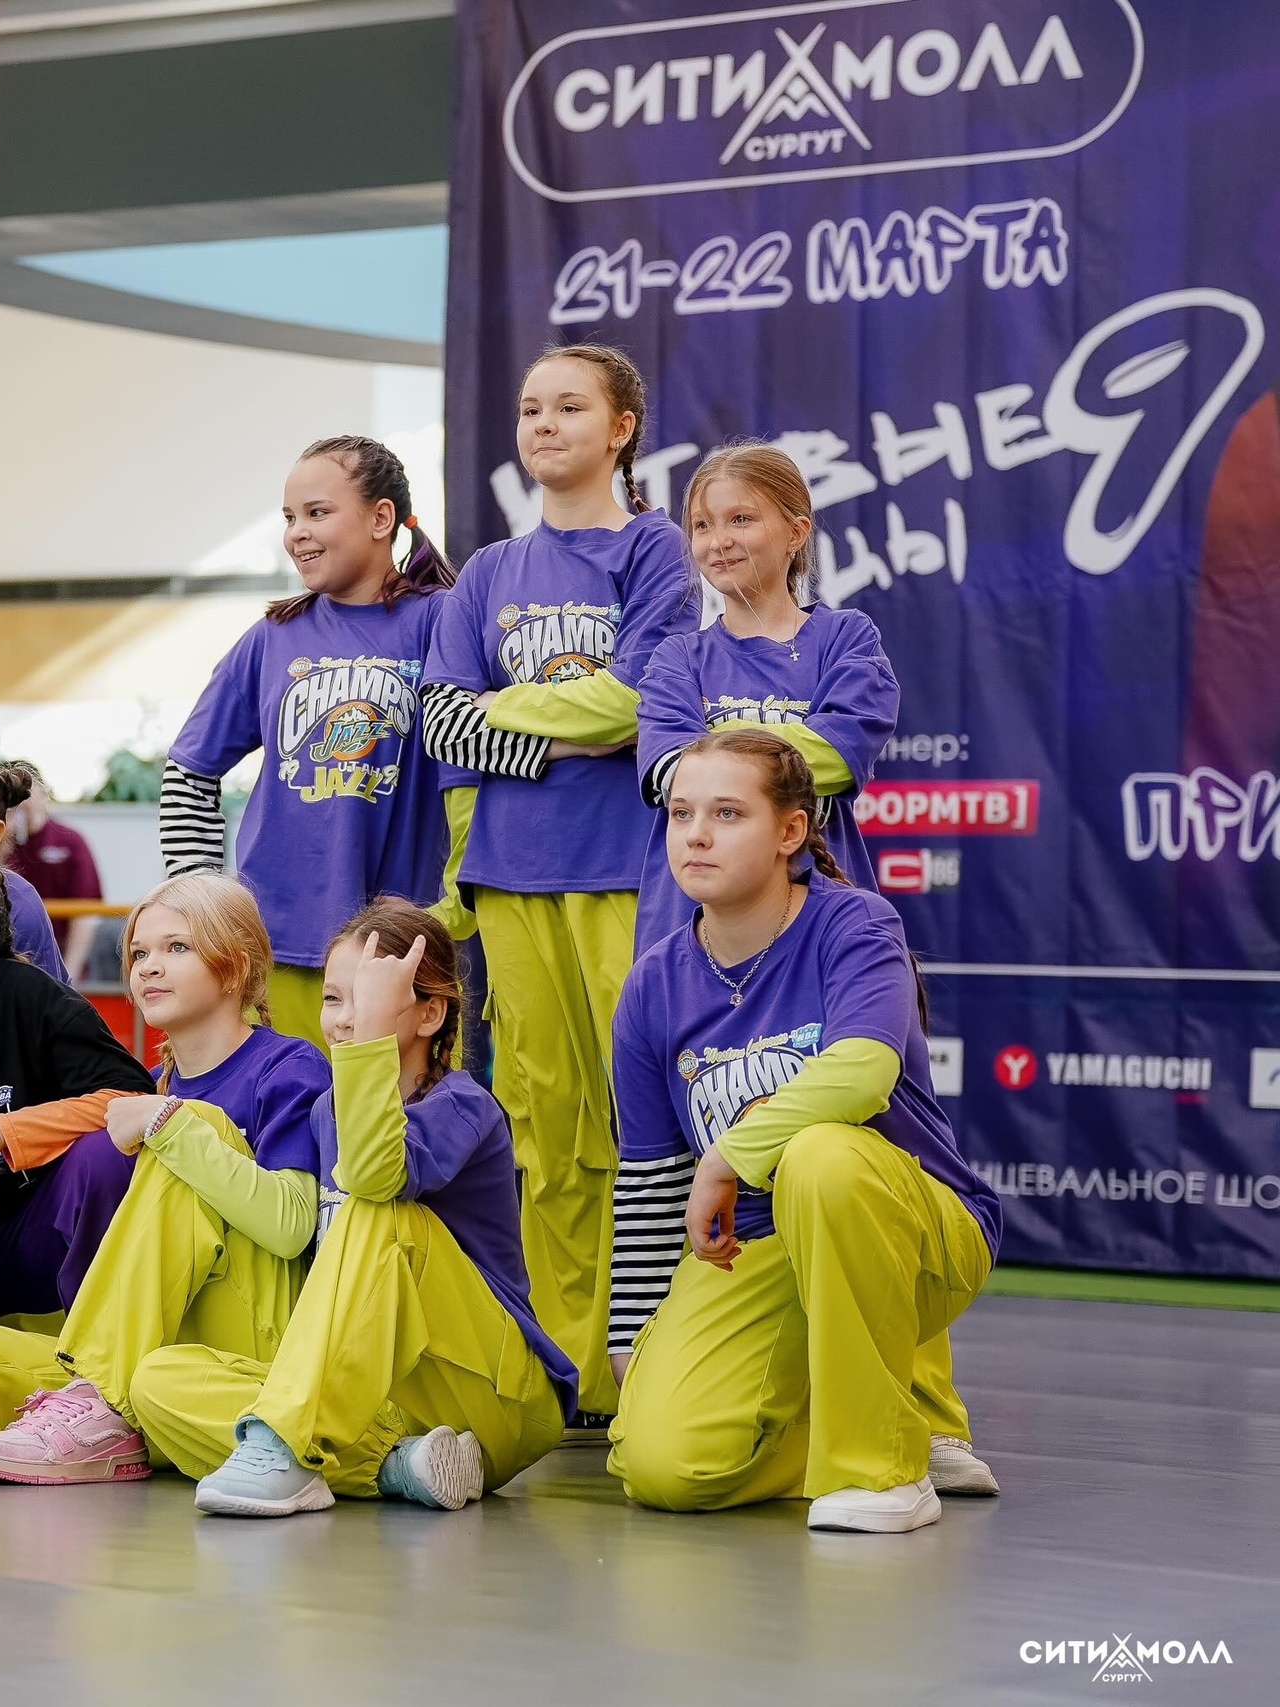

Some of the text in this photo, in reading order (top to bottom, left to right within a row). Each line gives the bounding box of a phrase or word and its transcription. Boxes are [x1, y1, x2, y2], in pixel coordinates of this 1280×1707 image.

[554, 14, 1084, 132] СИТИ МОЛЛ
[744, 128, 846, 162] СУРГУТ
[549, 198, 1069, 325] 21-22 МАРТА
[501, 614, 616, 684] CHAMP
[281, 666, 417, 754] CHAMPS
[311, 719, 391, 762] JAZZ
[879, 733, 970, 769] нер:
[300, 765, 384, 804] JAZZ
[338, 761, 380, 778] UTAH
[854, 785, 1028, 829] ФОРМТВ]
[1046, 1052, 1212, 1090] YAMAGUCHI
[690, 1052, 806, 1154] CHAMP
[970, 1159, 1207, 1204] НЦЕВАЛЬНОЕ
